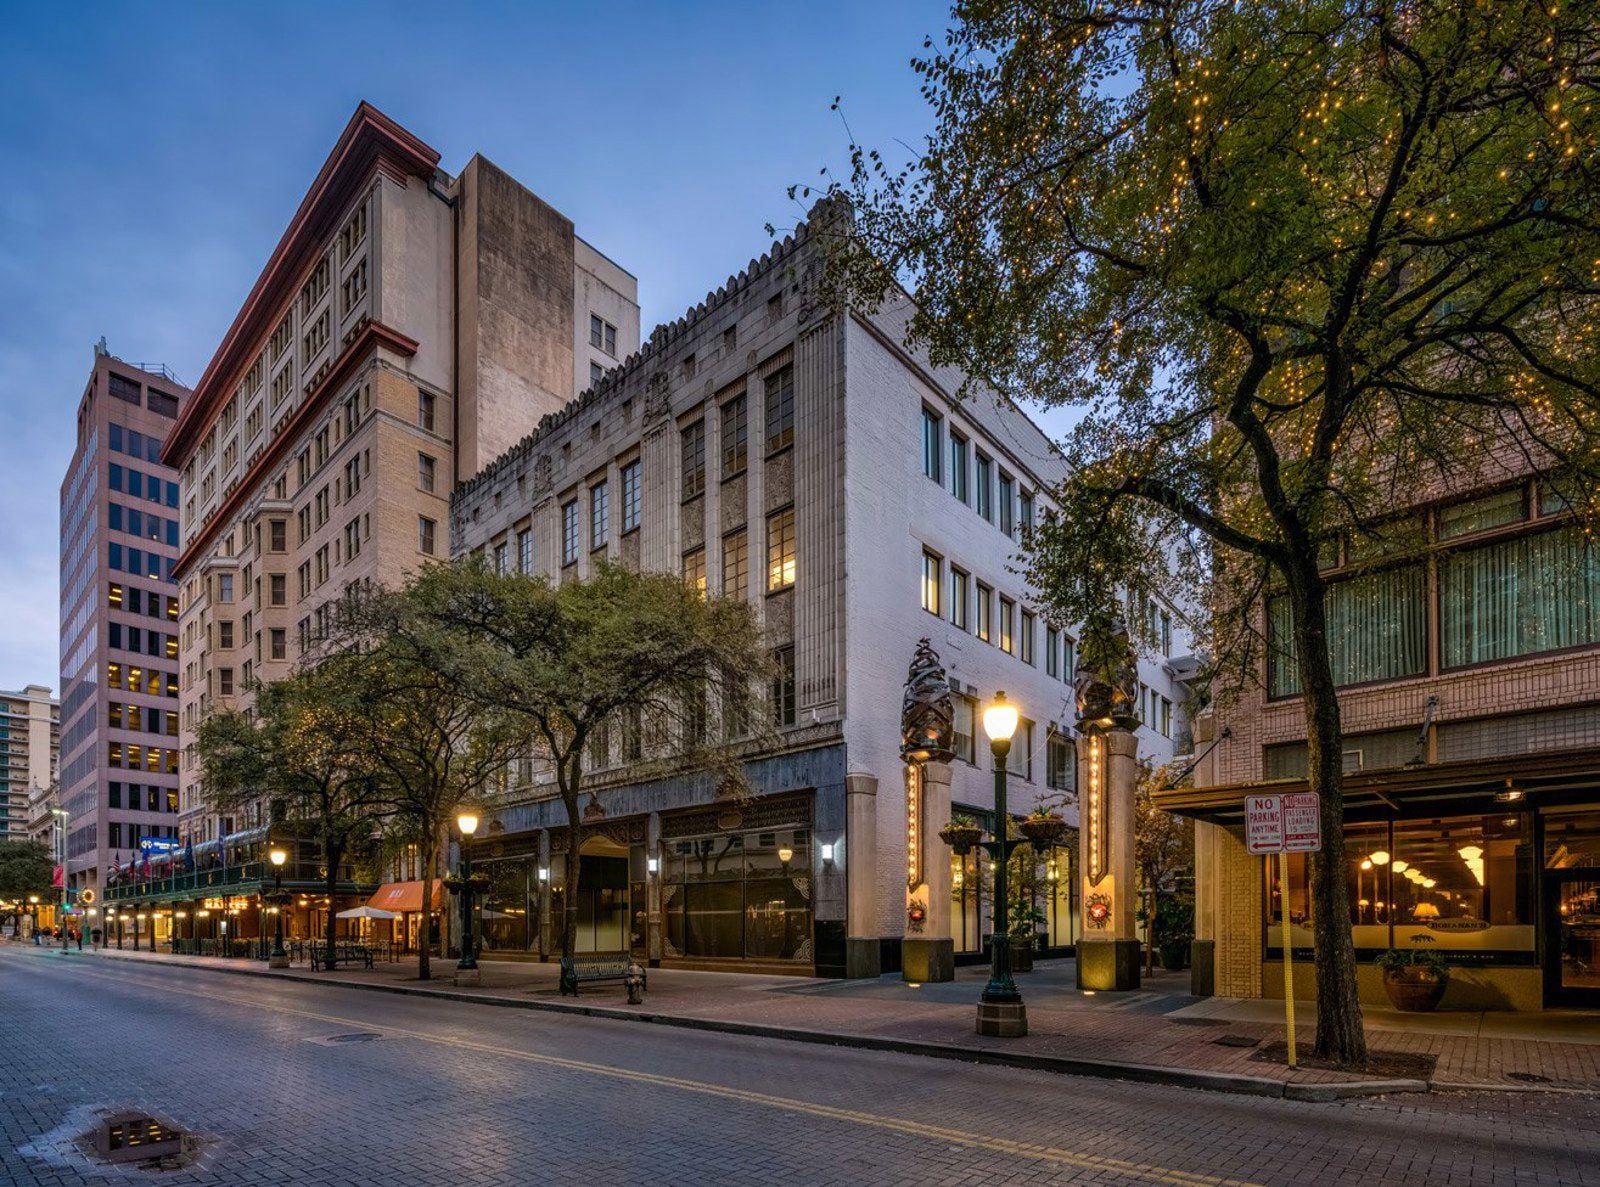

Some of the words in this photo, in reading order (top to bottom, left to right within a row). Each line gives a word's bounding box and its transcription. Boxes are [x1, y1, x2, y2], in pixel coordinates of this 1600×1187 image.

[1255, 799, 1273, 810] NO
[1250, 812, 1279, 823] PARKING
[1288, 817, 1314, 825] LOADING
[1251, 824, 1279, 833] ANYTIME
